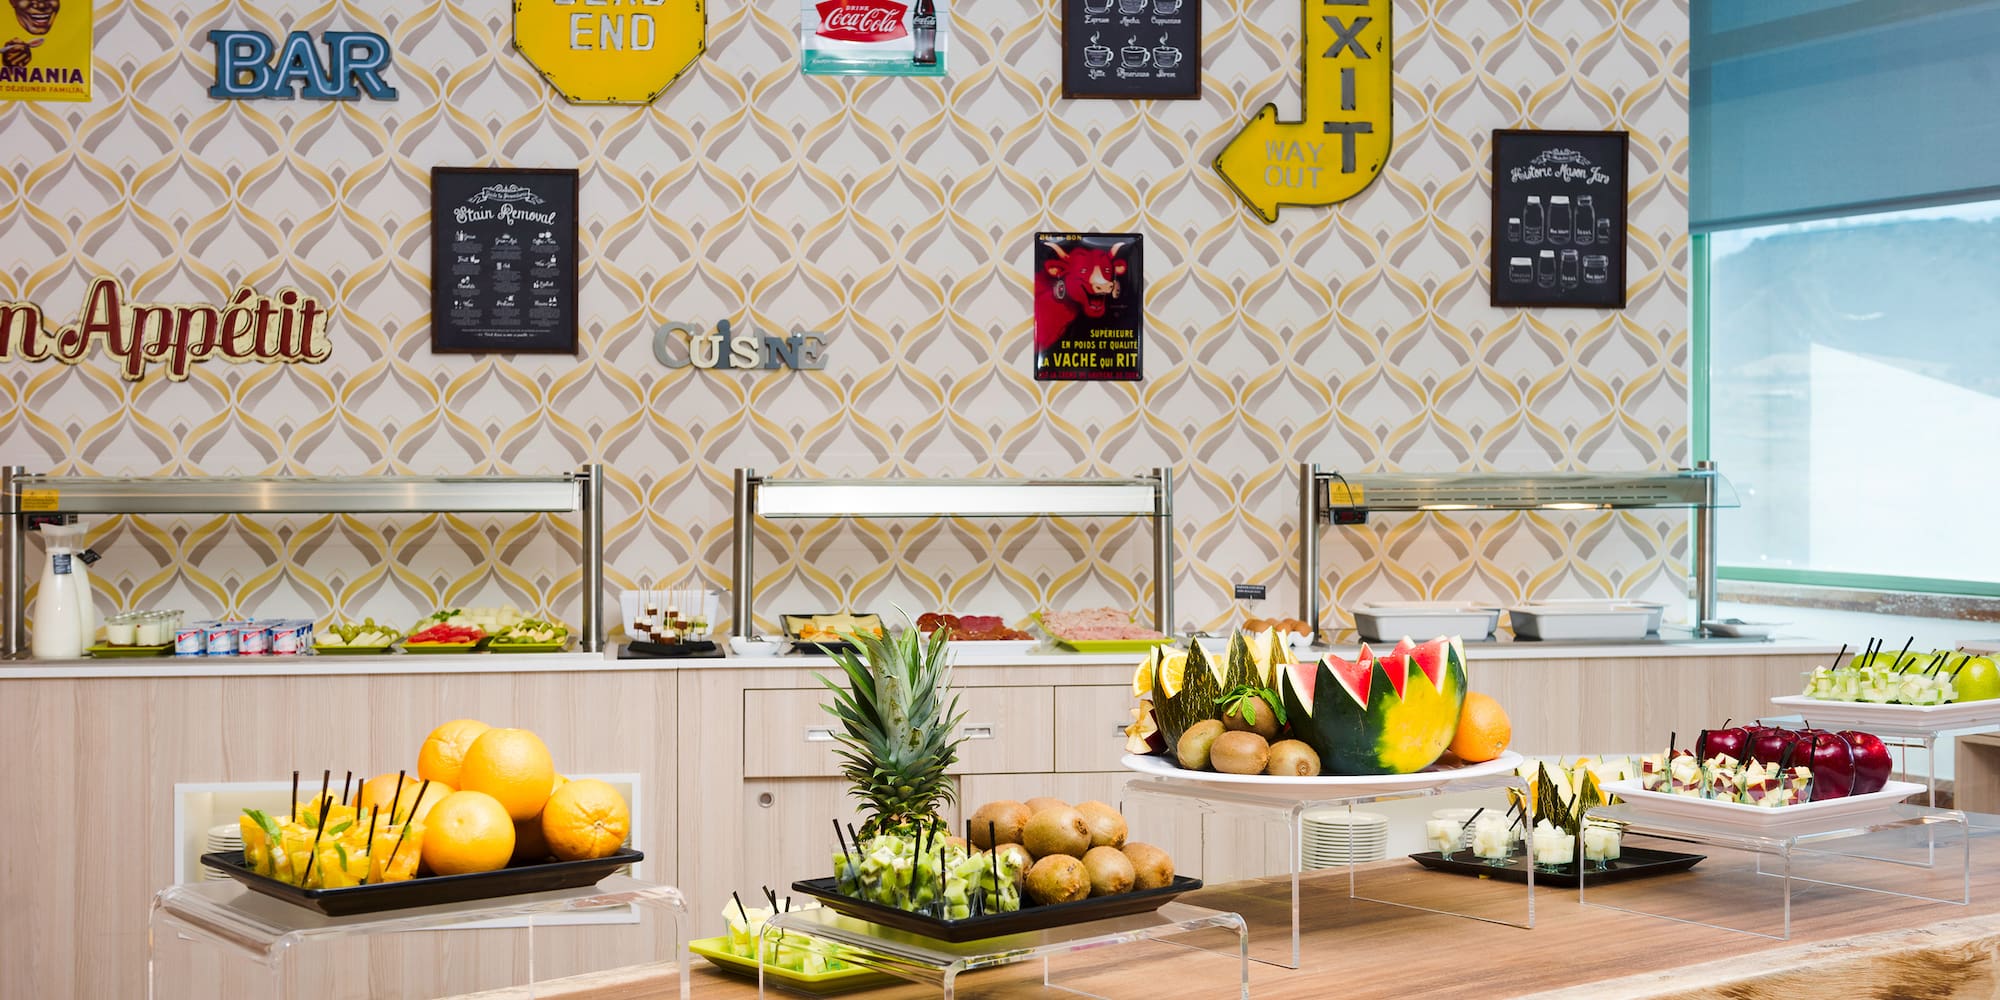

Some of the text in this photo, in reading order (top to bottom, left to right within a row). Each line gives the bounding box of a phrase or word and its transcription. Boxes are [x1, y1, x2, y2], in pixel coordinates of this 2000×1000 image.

[824, 6, 901, 33] Coca-Cola
[570, 12, 656, 52] END
[207, 31, 399, 101] BAR
[1322, 0, 1374, 174] XIT
[1265, 139, 1324, 163] WAY
[1264, 165, 1324, 189] OUT
[1511, 165, 1553, 183] Historic
[1554, 163, 1588, 183] Mason
[453, 203, 557, 225] Stain Removal
[60, 278, 326, 377] Appétit
[1061, 341, 1070, 349] EN
[1074, 341, 1096, 349] POIDS
[1099, 341, 1107, 349] ET
[1053, 352, 1098, 367] VACHE
[1100, 357, 1113, 369] QUI
[1116, 352, 1138, 367] RIT
